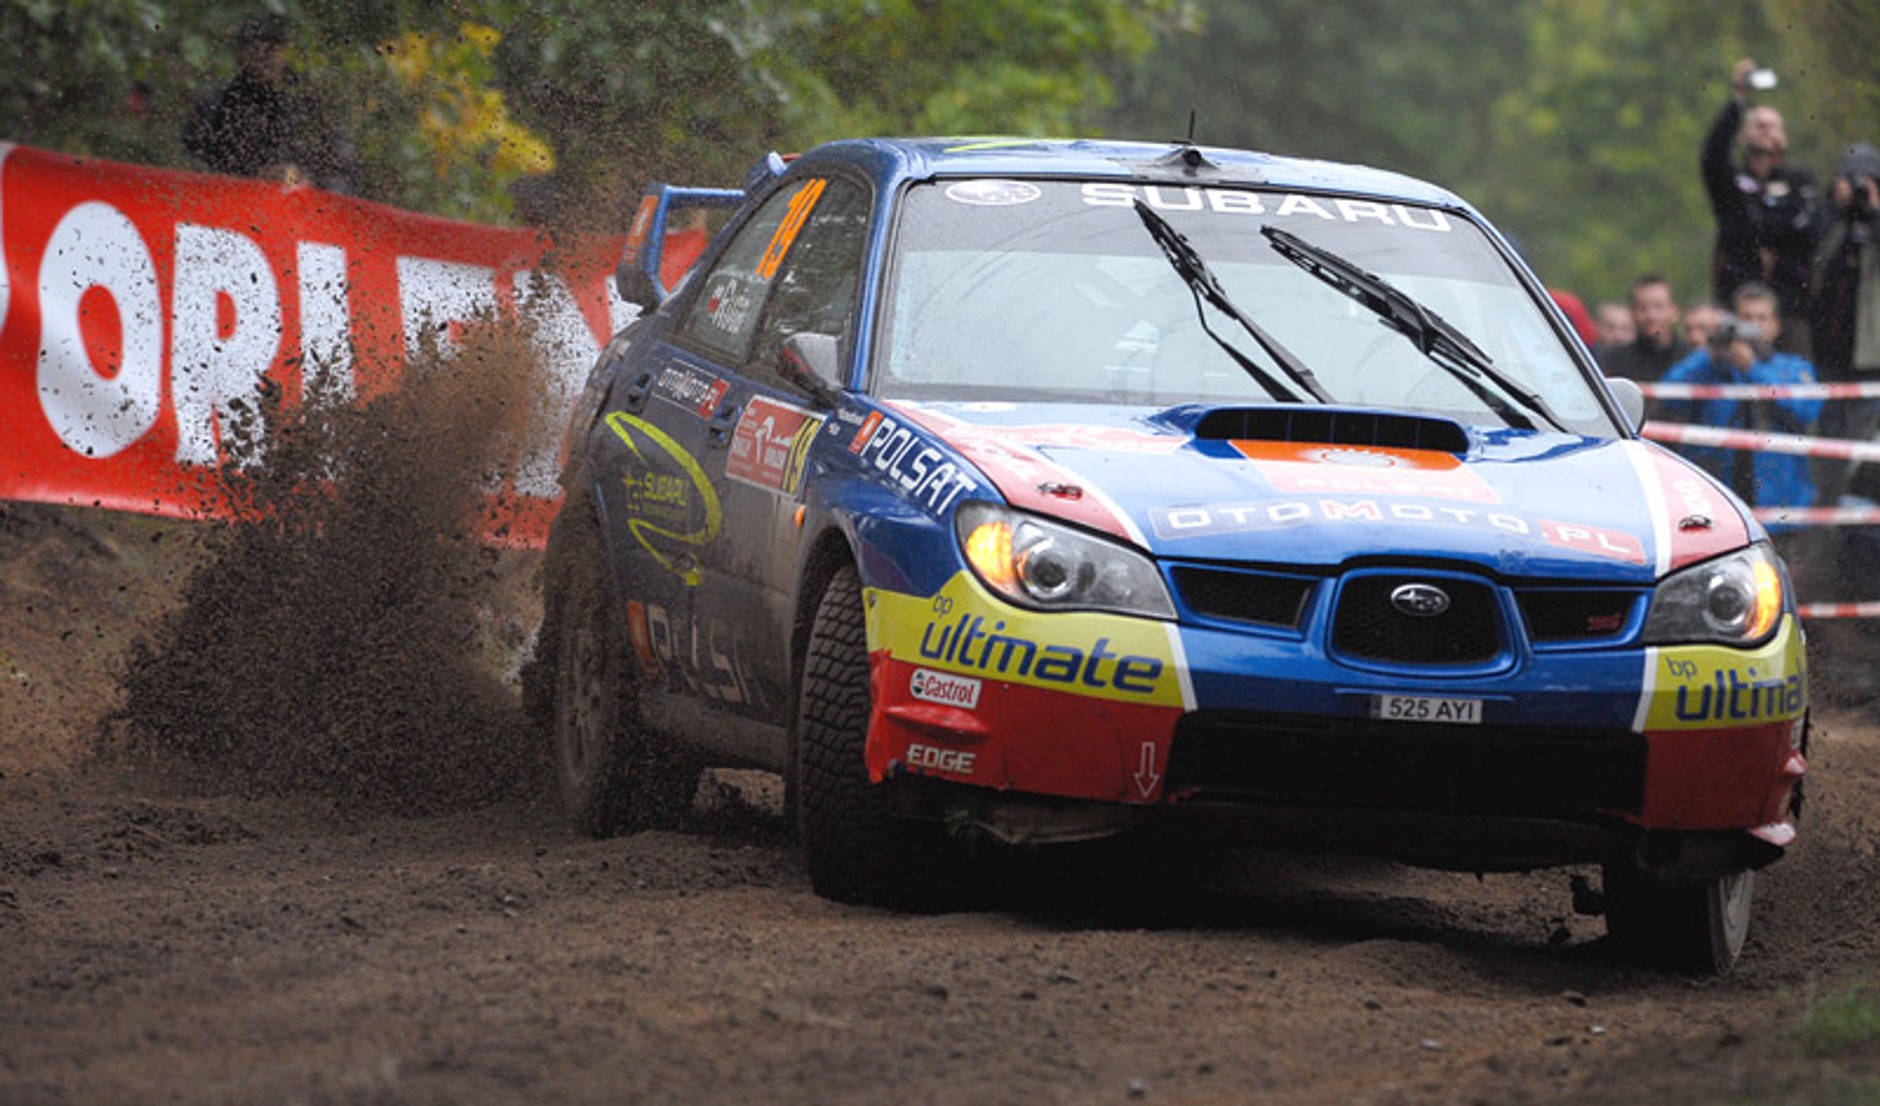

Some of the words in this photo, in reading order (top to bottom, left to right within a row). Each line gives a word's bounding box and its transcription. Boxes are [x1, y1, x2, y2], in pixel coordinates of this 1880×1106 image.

[1081, 184, 1451, 232] SUBARU
[860, 418, 977, 516] POLSAT
[1166, 500, 1629, 553] OTOMOTO.PL
[933, 593, 952, 618] bp
[920, 613, 1163, 694] ultimate
[1666, 657, 1697, 681] bp
[925, 676, 976, 703] Castrol
[1389, 698, 1430, 717] 525
[1436, 700, 1473, 720] AYI
[1676, 662, 1804, 721] ultima
[906, 744, 976, 774] EDGE
